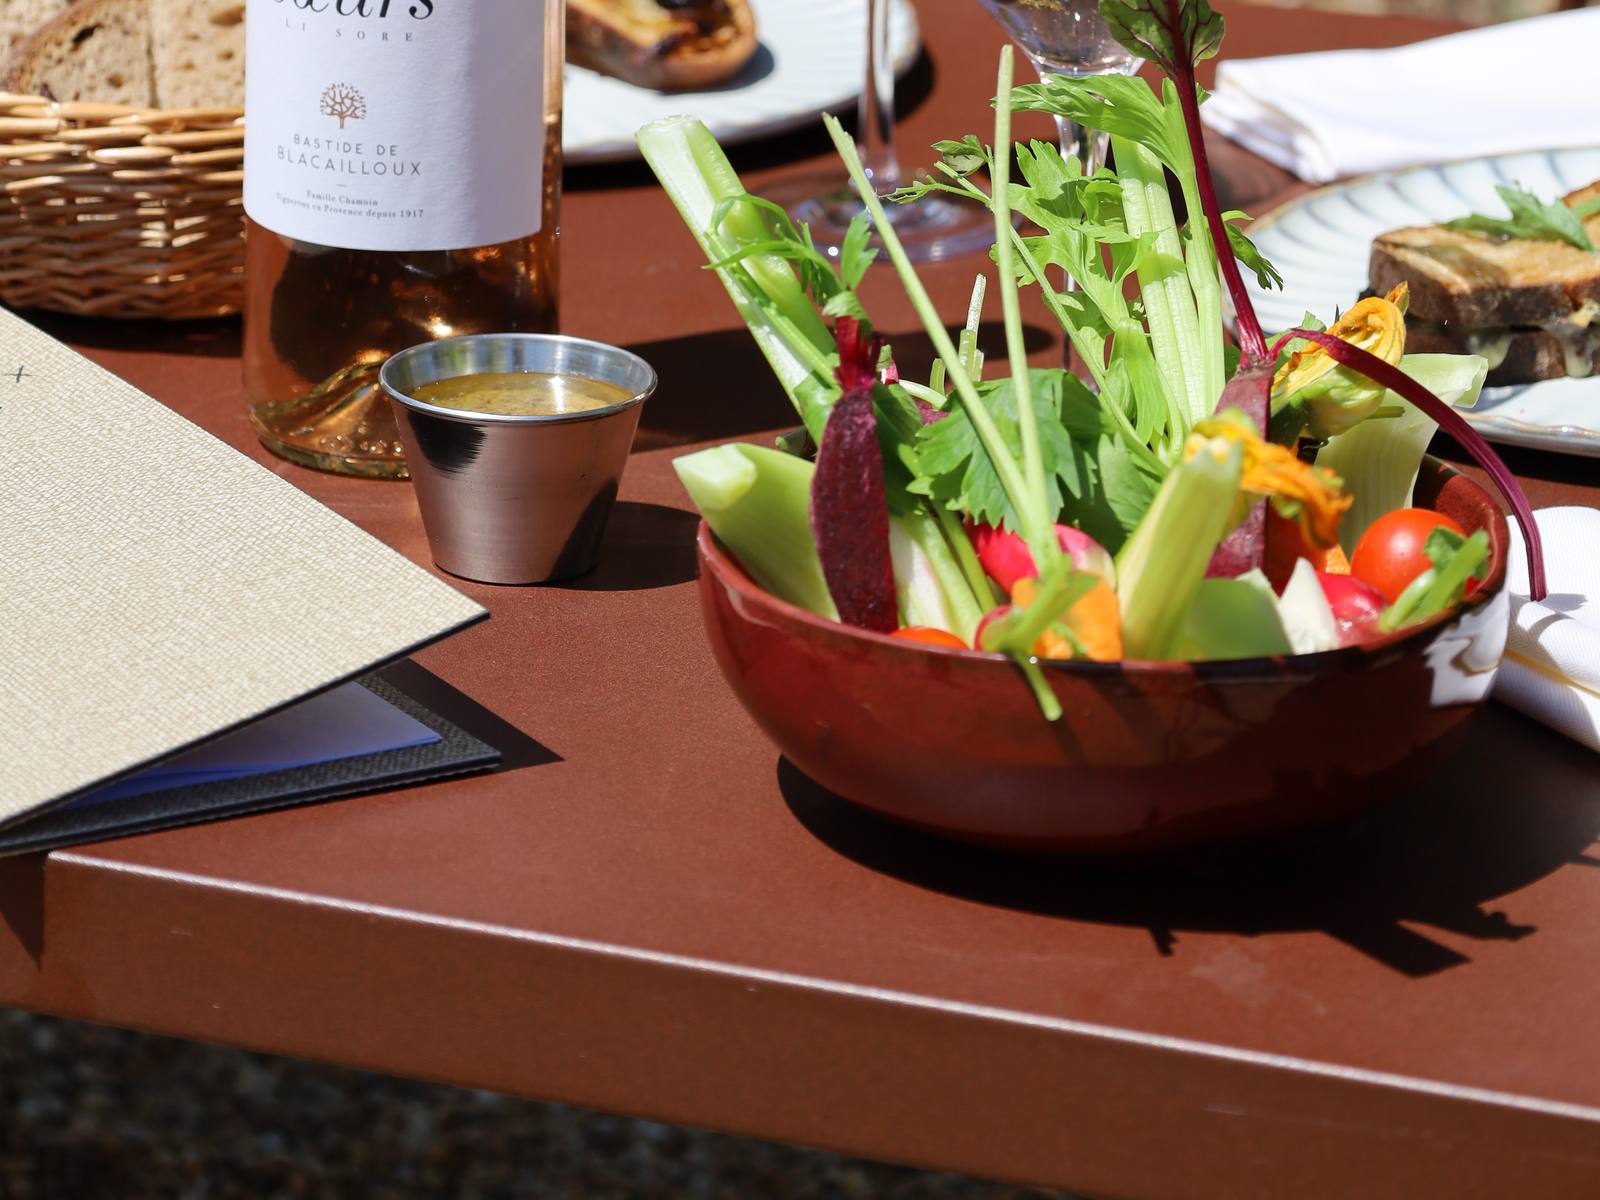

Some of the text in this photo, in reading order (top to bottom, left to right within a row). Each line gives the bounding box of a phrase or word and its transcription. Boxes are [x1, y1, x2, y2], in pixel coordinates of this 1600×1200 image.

[285, 16, 413, 42] LI SORE
[293, 133, 398, 157] BASTIDE DE
[277, 145, 421, 176] BLACAILLOUX
[306, 190, 336, 202] Famille
[312, 204, 321, 212] en
[323, 203, 363, 217] Provence
[365, 208, 396, 220] depuis
[400, 209, 424, 218] 1917
